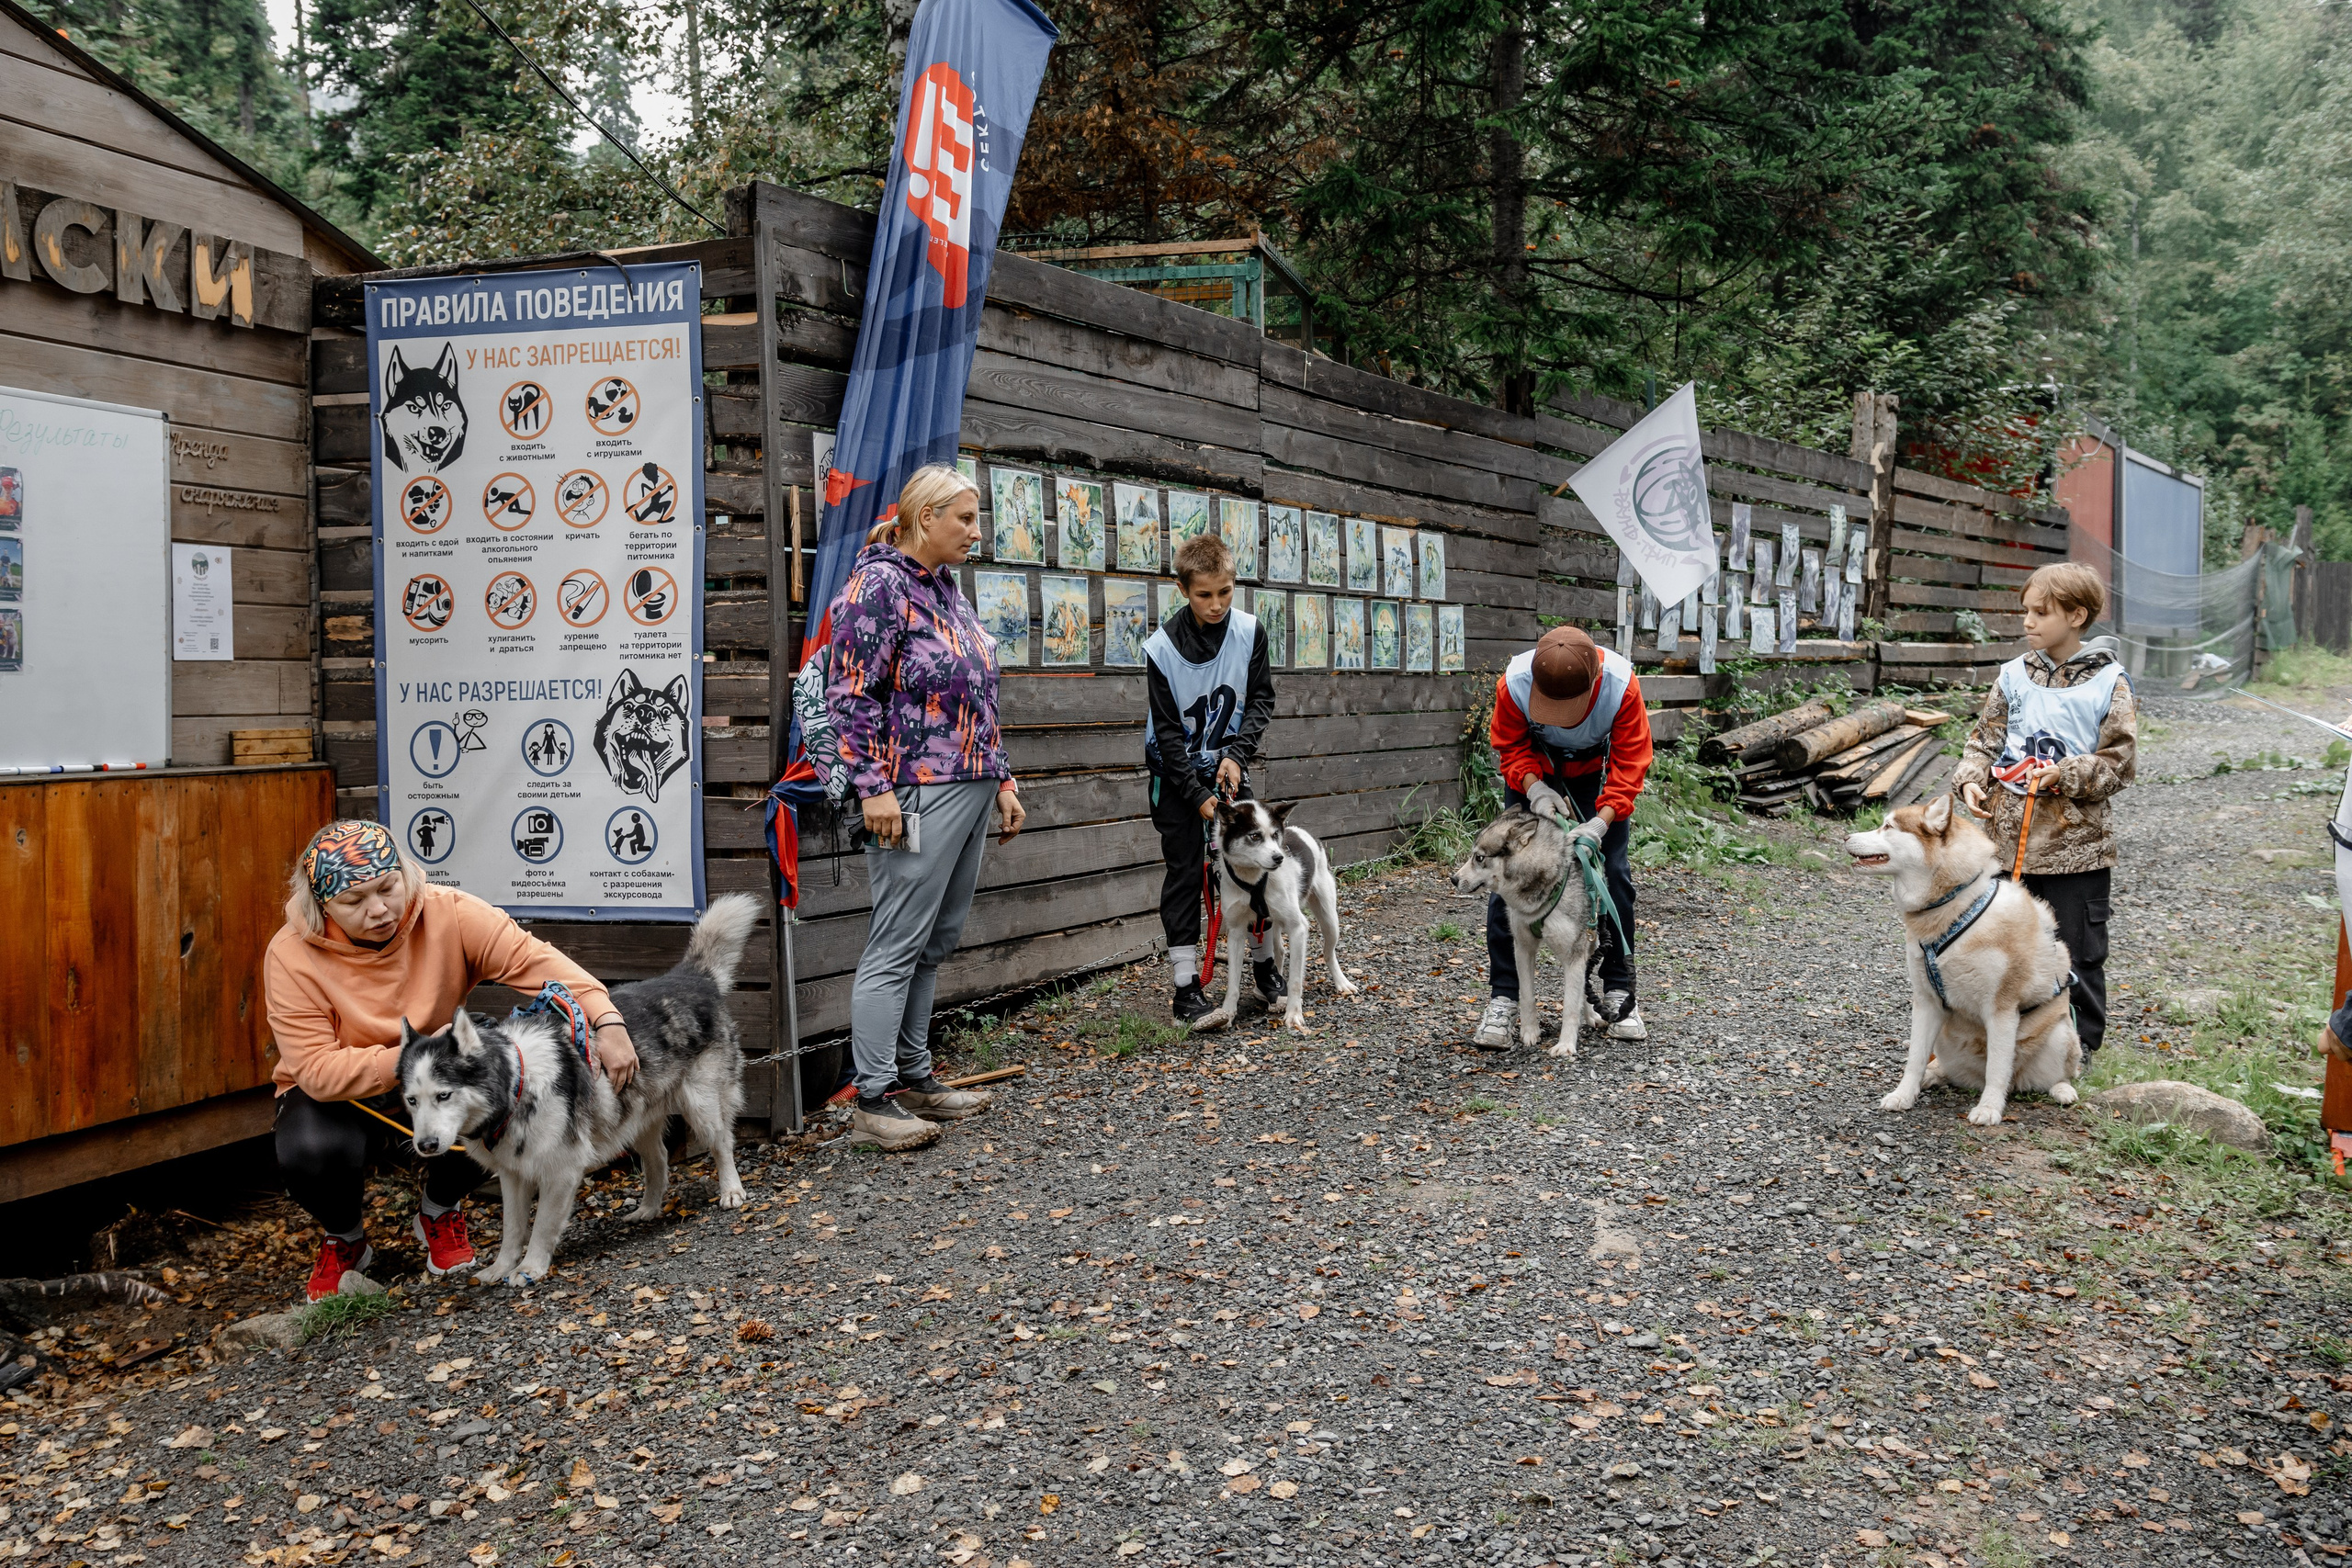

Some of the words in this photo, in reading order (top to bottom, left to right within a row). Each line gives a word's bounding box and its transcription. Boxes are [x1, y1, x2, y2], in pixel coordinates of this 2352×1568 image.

[381, 291, 508, 328] ПРАВИЛА
[515, 279, 685, 322] ПОВЕДЕНИЯ
[466, 348, 477, 370] У
[483, 346, 521, 368] НАС
[526, 337, 681, 367] ЗАПРЕЩАЕТСЯ!
[595, 436, 633, 448] входить
[510, 443, 547, 452] входить
[594, 446, 642, 459] игрушками
[506, 450, 556, 462] животными
[465, 536, 500, 545] входить
[509, 534, 554, 542] состоянии
[565, 532, 601, 542] кричать
[628, 530, 660, 539] бегать
[395, 540, 430, 548] входить
[438, 537, 459, 547] едой
[624, 542, 677, 552] территории
[409, 547, 454, 558] напитками
[481, 542, 538, 554] алкогольного
[487, 556, 533, 564] опьянения
[627, 550, 675, 561] питомника
[487, 635, 537, 645] хулиганить
[563, 633, 600, 642] курение
[633, 631, 668, 641] туалета
[409, 637, 449, 647] мусорить
[630, 639, 683, 651] территории
[498, 645, 535, 655] драться
[559, 643, 607, 653] запрещено
[619, 649, 666, 660] питомника
[399, 682, 410, 704] У
[415, 681, 453, 704] НАС
[458, 678, 603, 703] РАЗРЕШАЕТСЯ!
[1182, 683, 1238, 755] 12
[423, 781, 444, 790] быть
[526, 781, 560, 789] следить
[407, 793, 460, 801] осторожным
[549, 791, 582, 800] детьми
[525, 869, 548, 878] фото
[630, 869, 675, 878] собаками-
[425, 879, 460, 887] совода
[511, 878, 567, 888] видеосъёмка
[609, 881, 662, 890] разрешения
[516, 890, 564, 899] разрешены
[603, 888, 662, 900] экскурсовода
